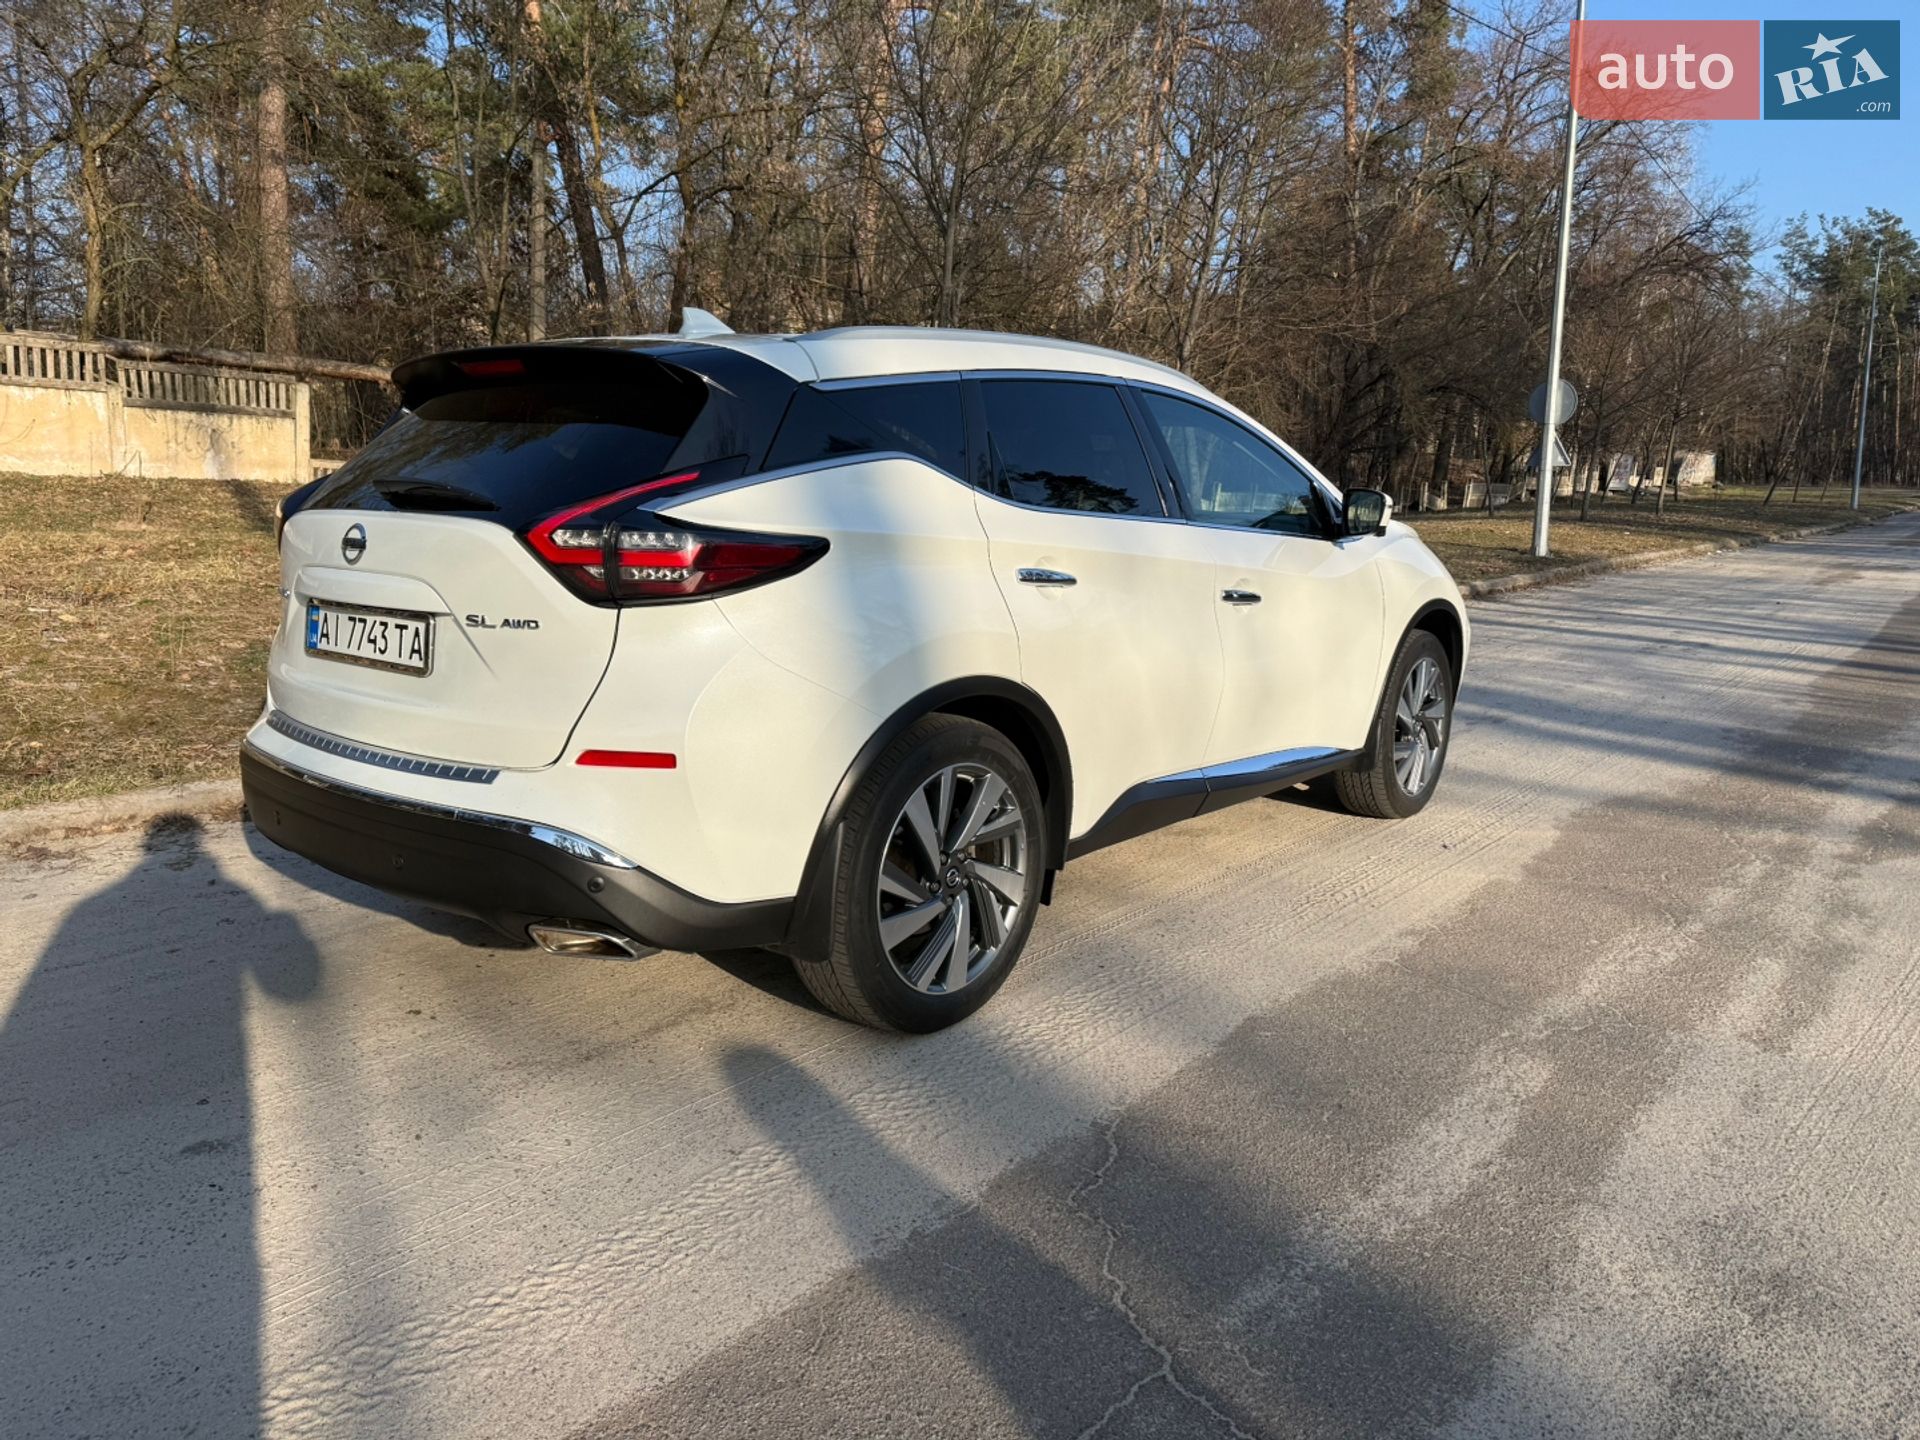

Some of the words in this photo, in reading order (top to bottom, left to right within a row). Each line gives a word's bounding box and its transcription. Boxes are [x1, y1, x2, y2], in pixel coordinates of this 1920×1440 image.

[319, 612, 339, 647] AI
[347, 616, 388, 655] 7743
[394, 623, 423, 661] TA
[465, 614, 497, 629] SL
[500, 618, 540, 630] AWD
